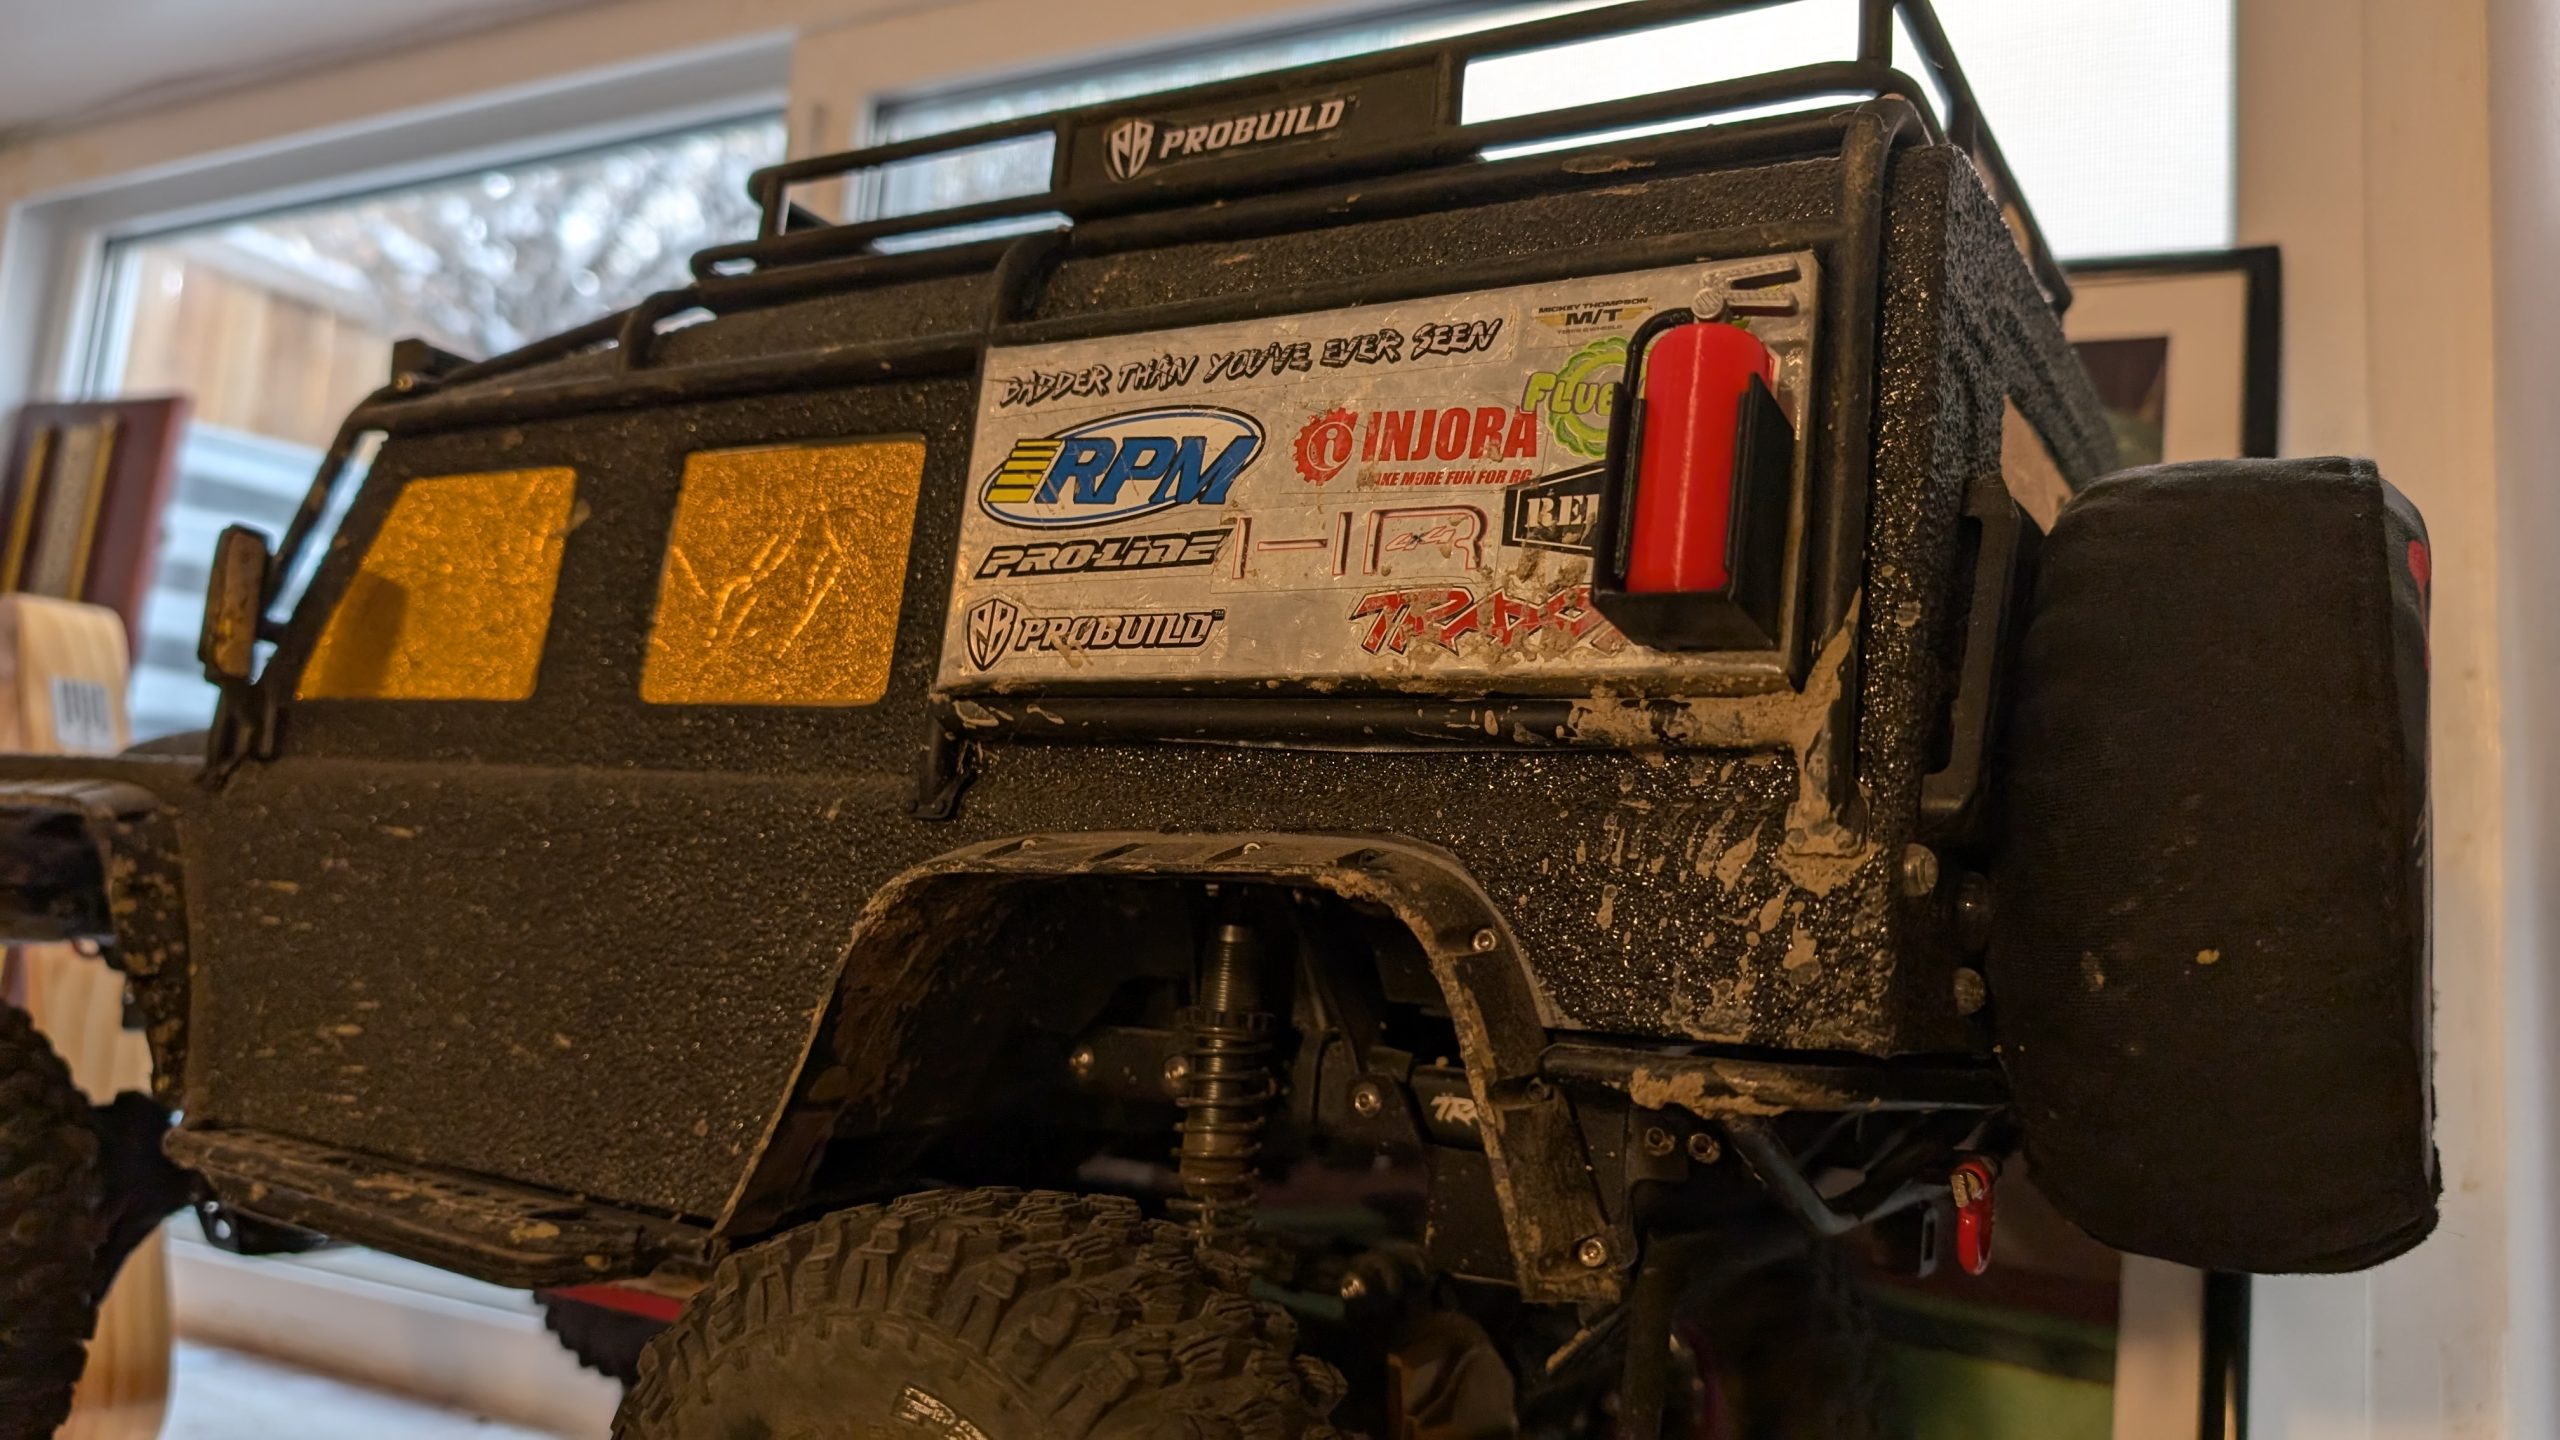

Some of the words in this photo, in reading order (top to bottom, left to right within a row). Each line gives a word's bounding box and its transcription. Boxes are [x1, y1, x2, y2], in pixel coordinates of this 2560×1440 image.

[1159, 100, 1346, 159] PROBUILD
[1538, 304, 1581, 313] MICKEY
[1582, 297, 1649, 309] THOMPSON
[1565, 309, 1623, 326] M/T
[1001, 370, 1112, 407] BADDER
[1118, 354, 1199, 393] THAN
[1203, 341, 1312, 384] YOU'VE
[1320, 328, 1404, 368] EVER
[1411, 318, 1503, 360] SEEN
[1361, 407, 1537, 462] INJORA
[1034, 436, 1260, 504] RPM
[1364, 472, 1400, 486] AKE
[1401, 470, 1444, 486] MORE
[1445, 470, 1474, 485] FUN
[1476, 469, 1505, 484] FOR
[1509, 468, 1533, 484] RC
[1014, 613, 1217, 650] PROBUILD
[1430, 1096, 1480, 1126] TR
